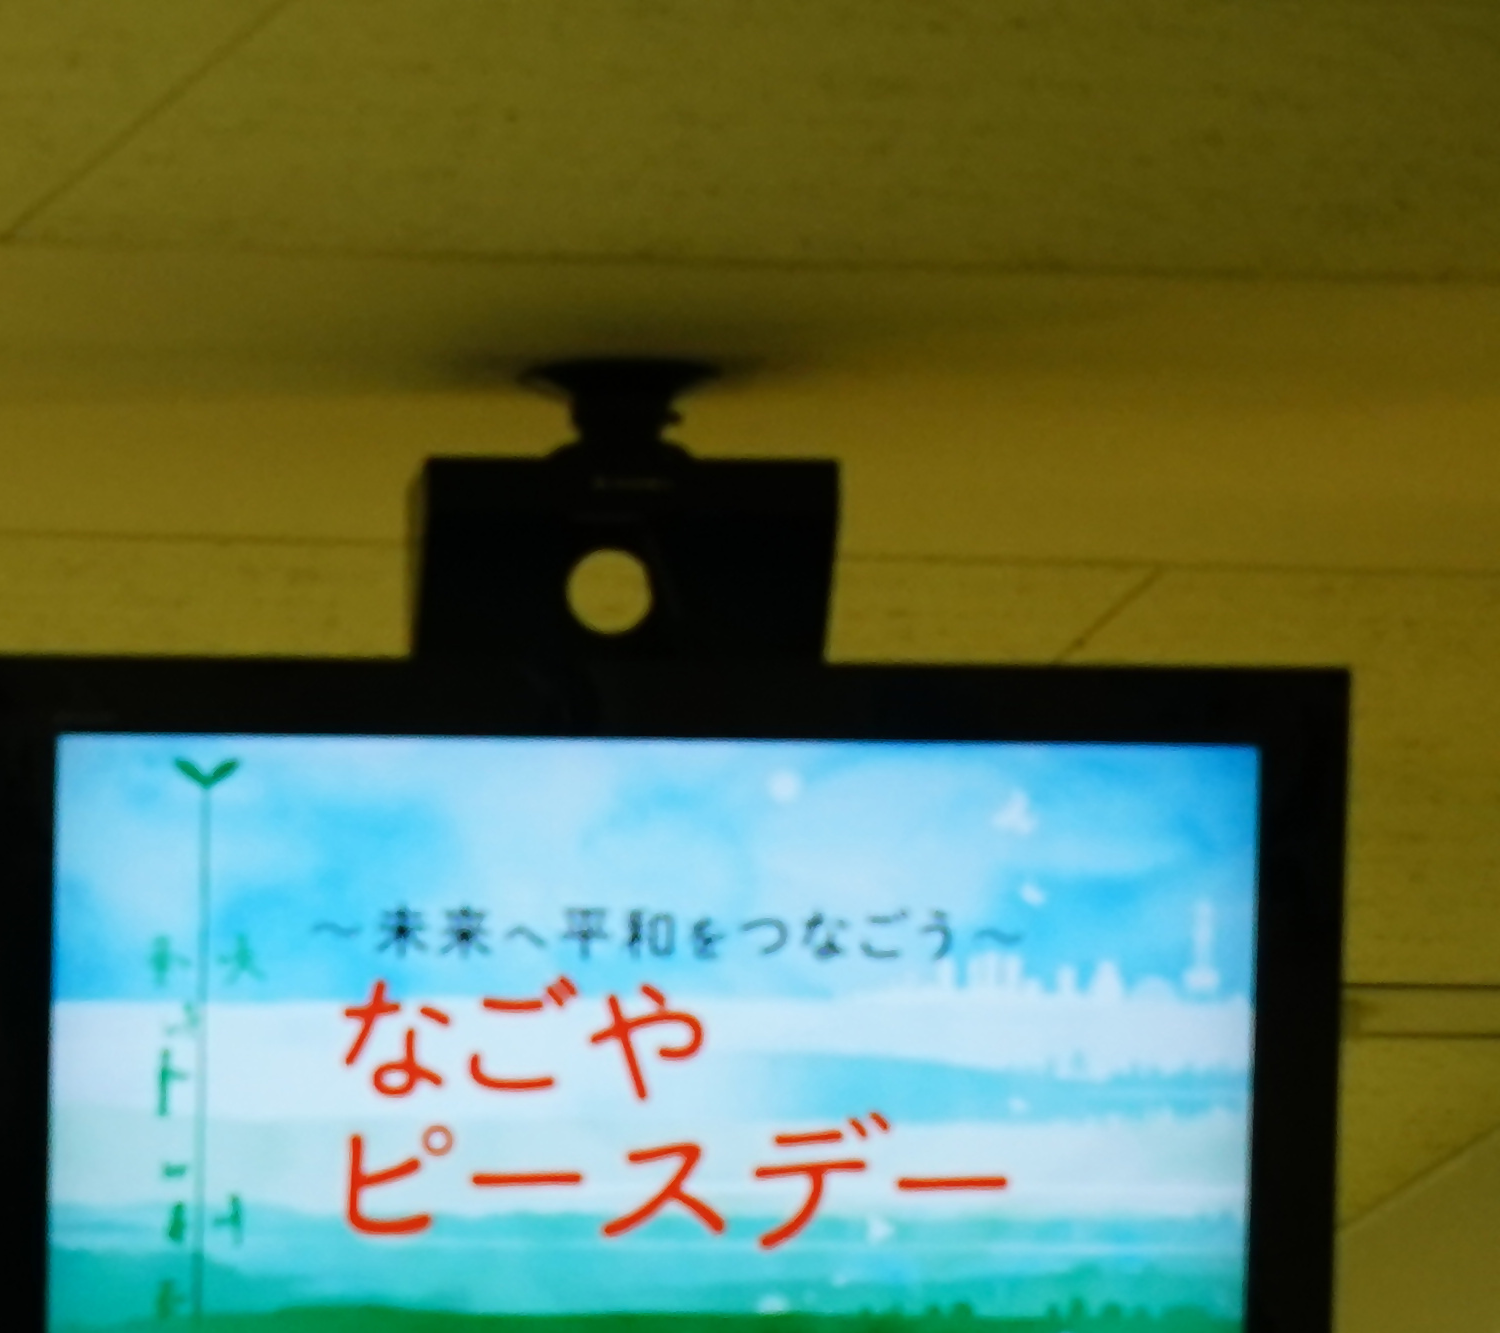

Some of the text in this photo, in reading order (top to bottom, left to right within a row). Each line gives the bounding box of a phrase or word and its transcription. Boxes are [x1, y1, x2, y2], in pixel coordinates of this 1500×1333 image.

[342, 976, 705, 1100] なごや
[346, 1112, 1009, 1248] ピースデー
